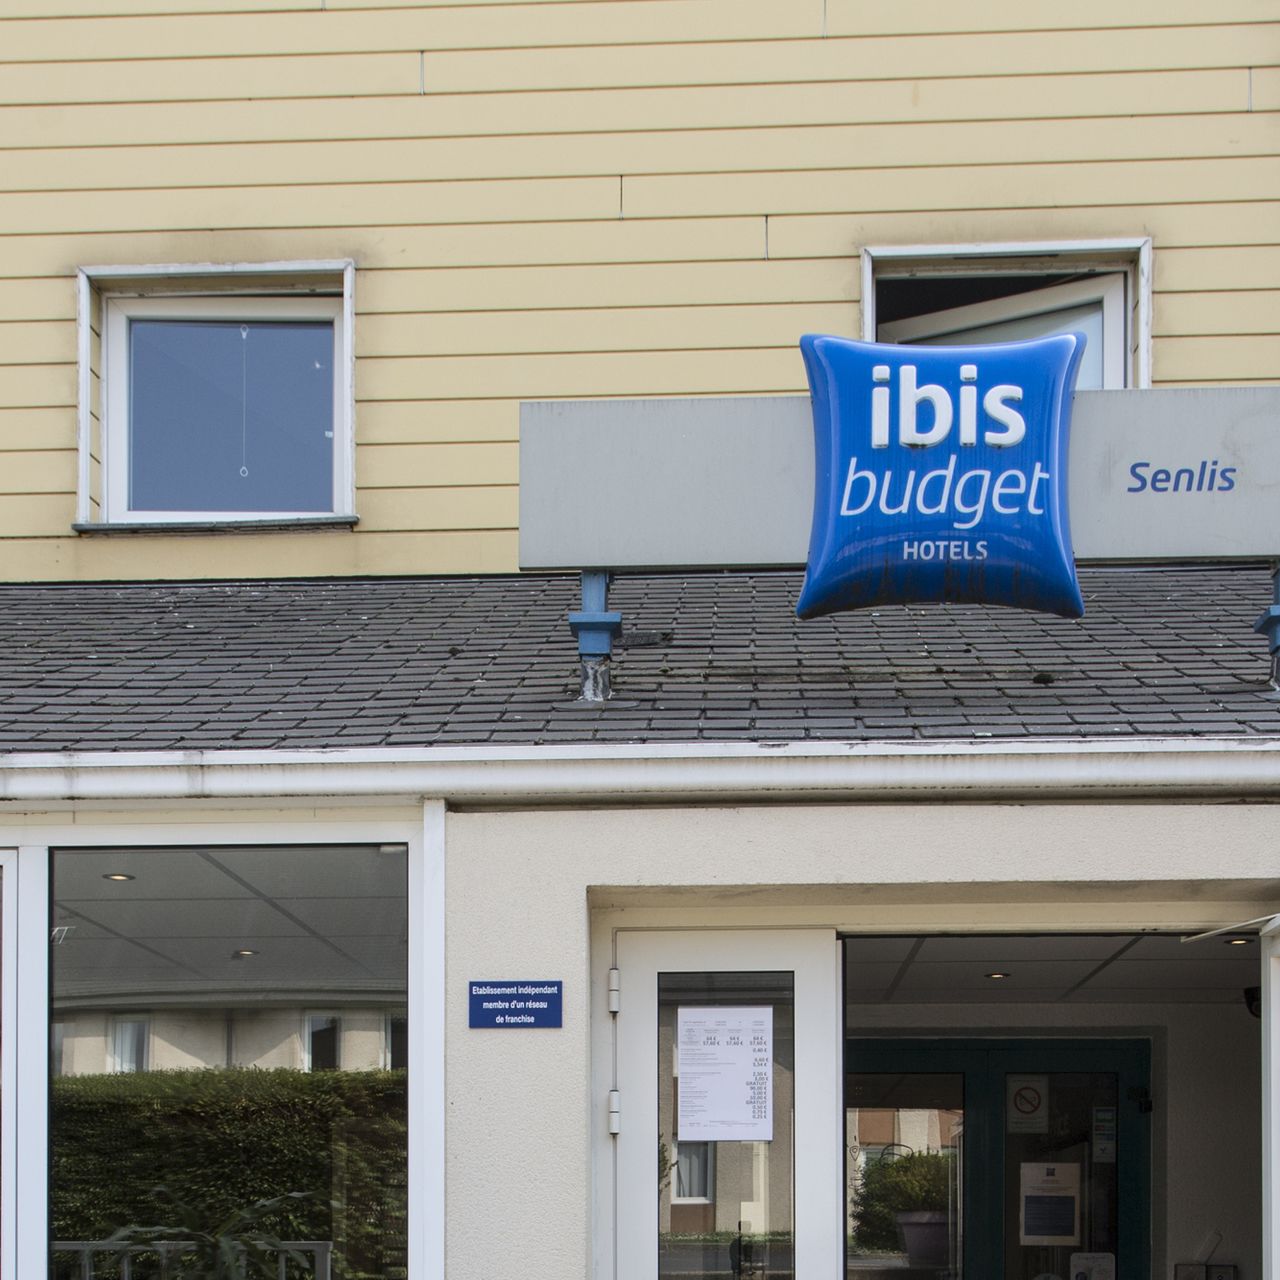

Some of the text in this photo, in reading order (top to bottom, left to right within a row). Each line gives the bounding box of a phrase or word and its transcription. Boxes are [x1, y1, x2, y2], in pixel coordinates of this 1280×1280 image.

[871, 364, 1026, 449] ibis
[1127, 460, 1236, 493] Senlis
[839, 454, 1050, 529] budget
[903, 540, 988, 560] HOTELS
[472, 985, 558, 995] Etablissement indépendant
[482, 1000, 548, 1008] membre d'un réseau
[495, 1014, 535, 1023] de franchise
